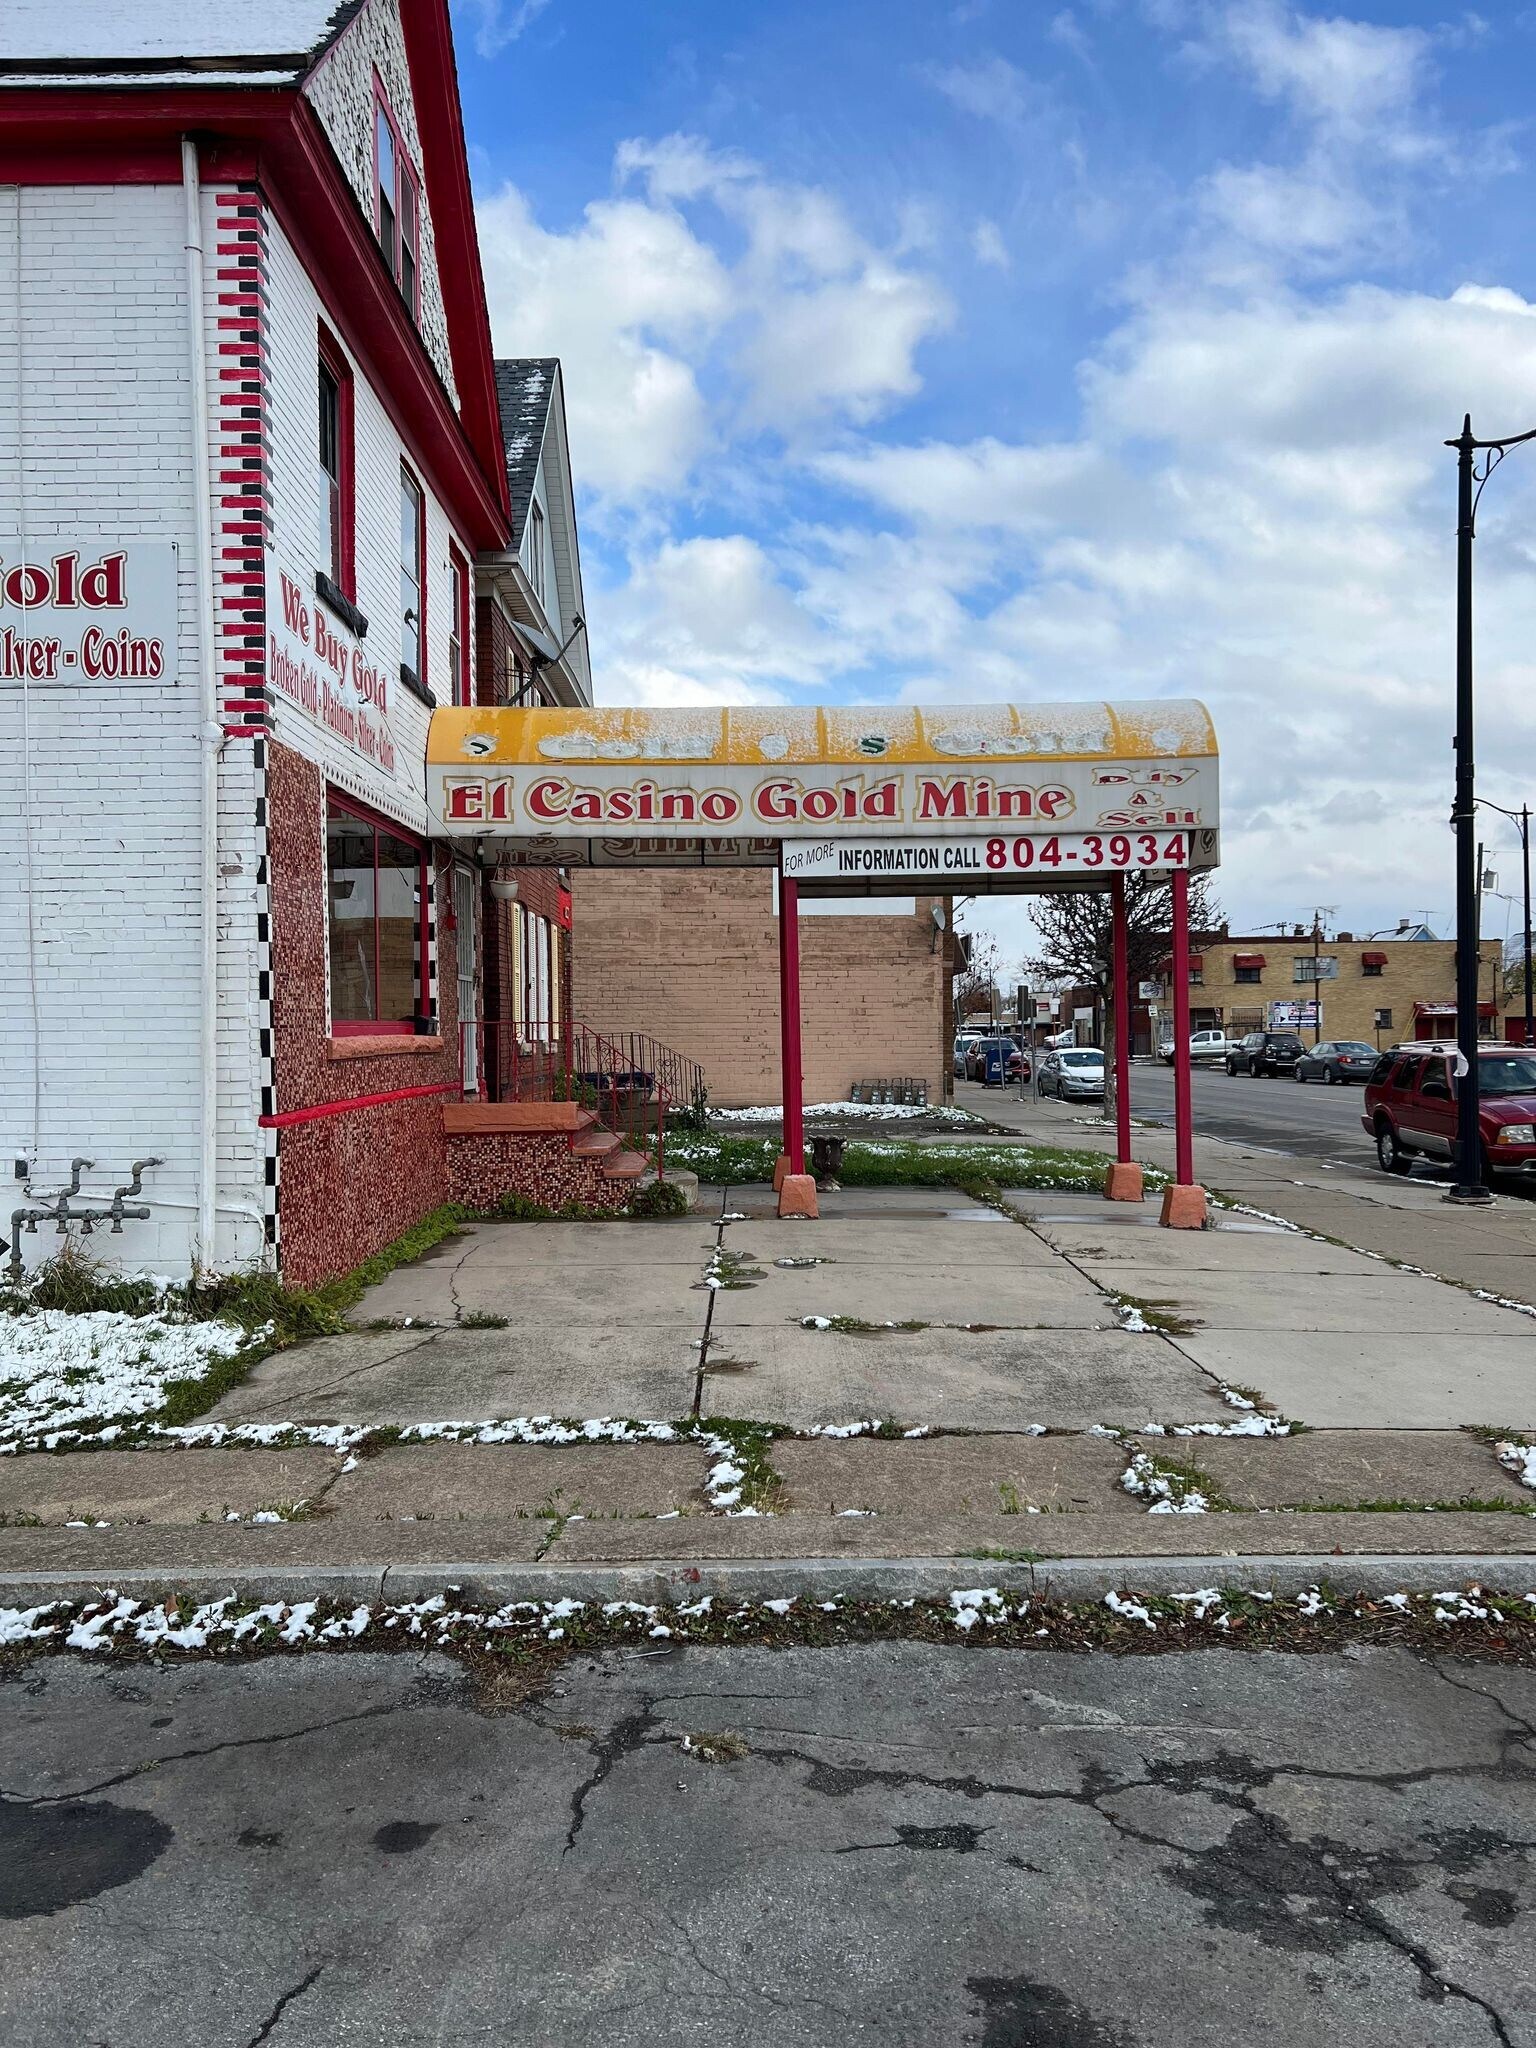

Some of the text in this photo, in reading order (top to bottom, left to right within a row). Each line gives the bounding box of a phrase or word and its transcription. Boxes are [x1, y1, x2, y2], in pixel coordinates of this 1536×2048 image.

[0, 551, 127, 609] old
[0, 626, 60, 679] lver
[82, 626, 163, 680] Coins
[279, 567, 387, 716] We Buy Gold
[269, 631, 300, 702] Broken
[300, 659, 317, 717] Gold
[322, 677, 354, 742] Platinum
[358, 708, 375, 759] Silver
[379, 727, 395, 774] Coins
[446, 777, 1073, 823] El Casino Gold Mine
[784, 853, 804, 873] FOR
[806, 842, 835, 866] MORE
[838, 848, 939, 871] INFORMATION
[943, 847, 981, 869] CALL
[985, 833, 1187, 869] 804-3934
